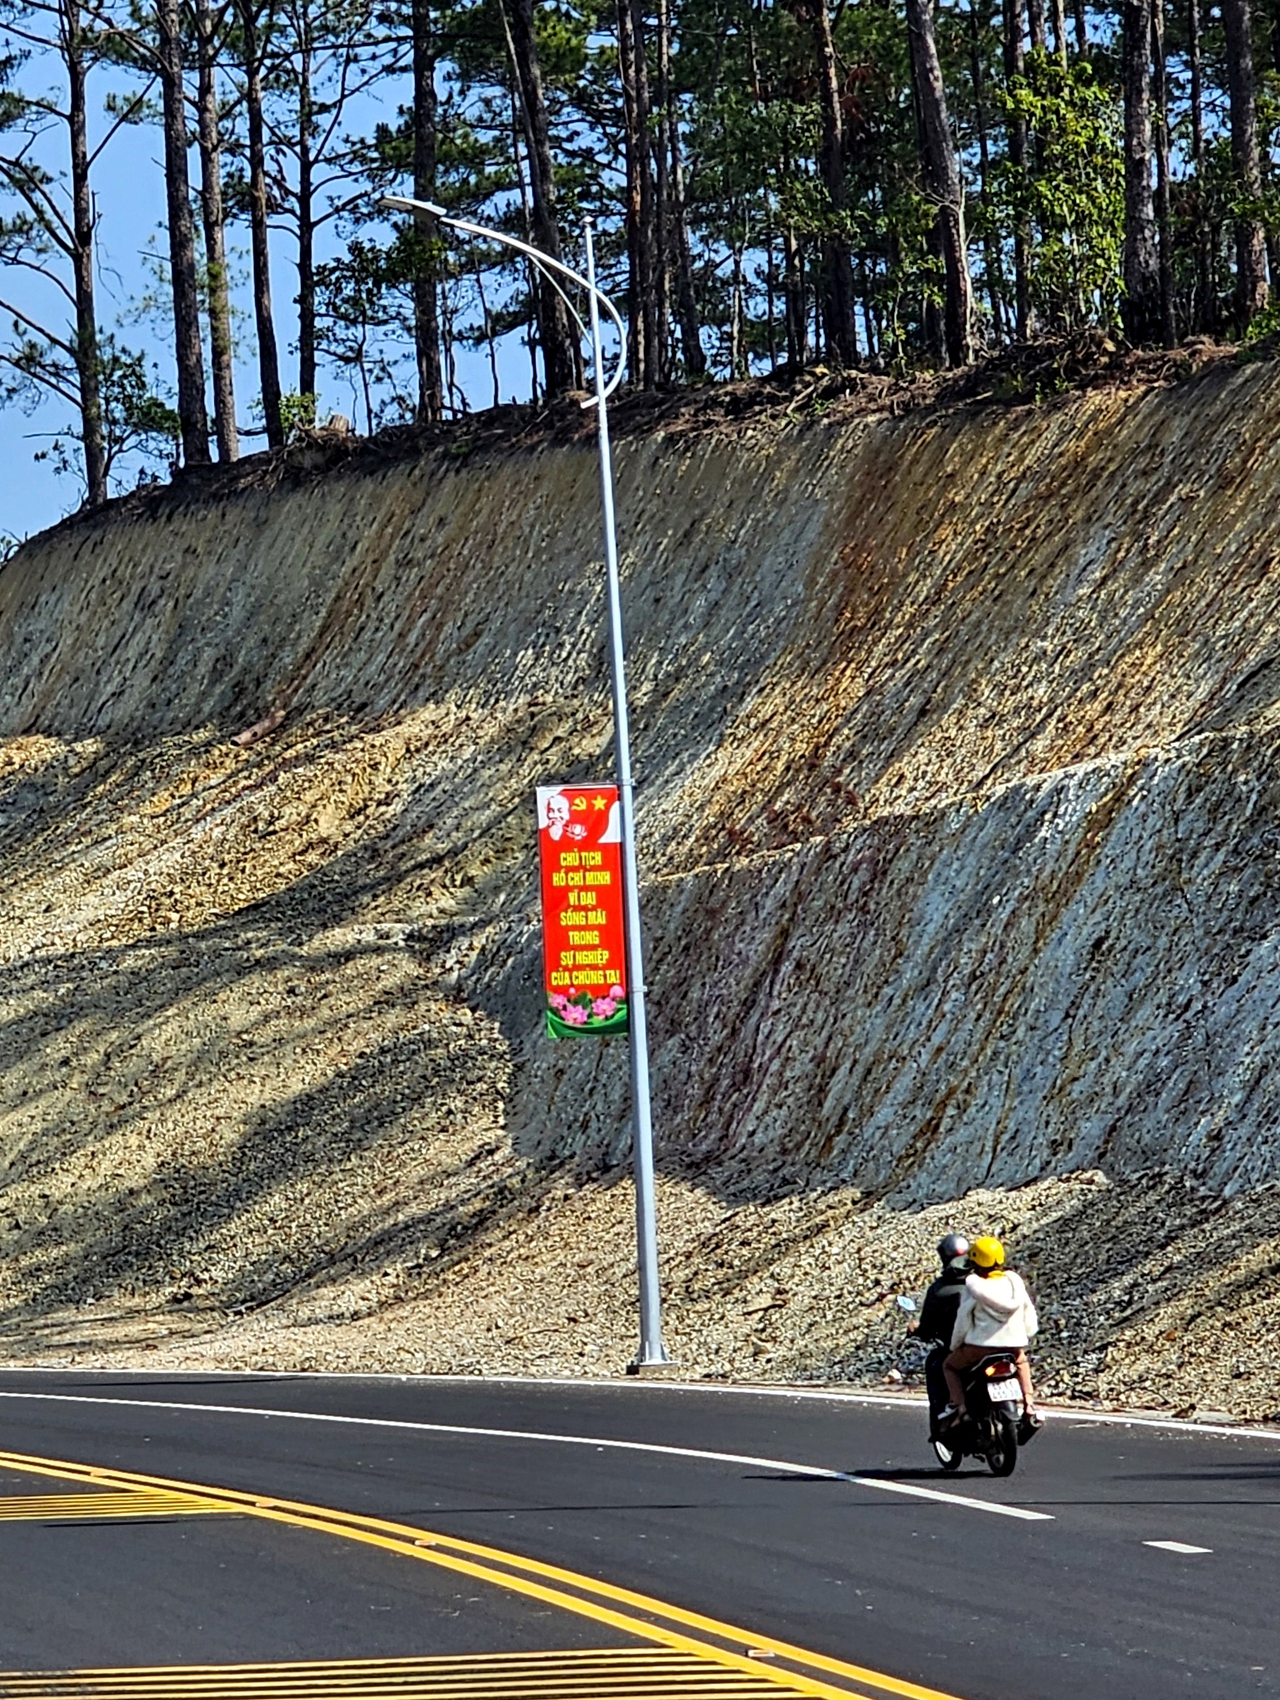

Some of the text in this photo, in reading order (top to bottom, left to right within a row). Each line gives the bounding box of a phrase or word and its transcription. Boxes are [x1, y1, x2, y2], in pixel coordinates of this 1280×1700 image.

[581, 851, 602, 869] TỊCH
[568, 869, 584, 886] CHÍ
[585, 871, 611, 885] MINH
[580, 891, 596, 908] ĐẠI
[560, 907, 586, 926] SỐNG
[568, 930, 600, 945] TRONG
[560, 948, 609, 968] SỰ NGHIỆP
[551, 967, 620, 985] CỦA CHÚNG TA!
